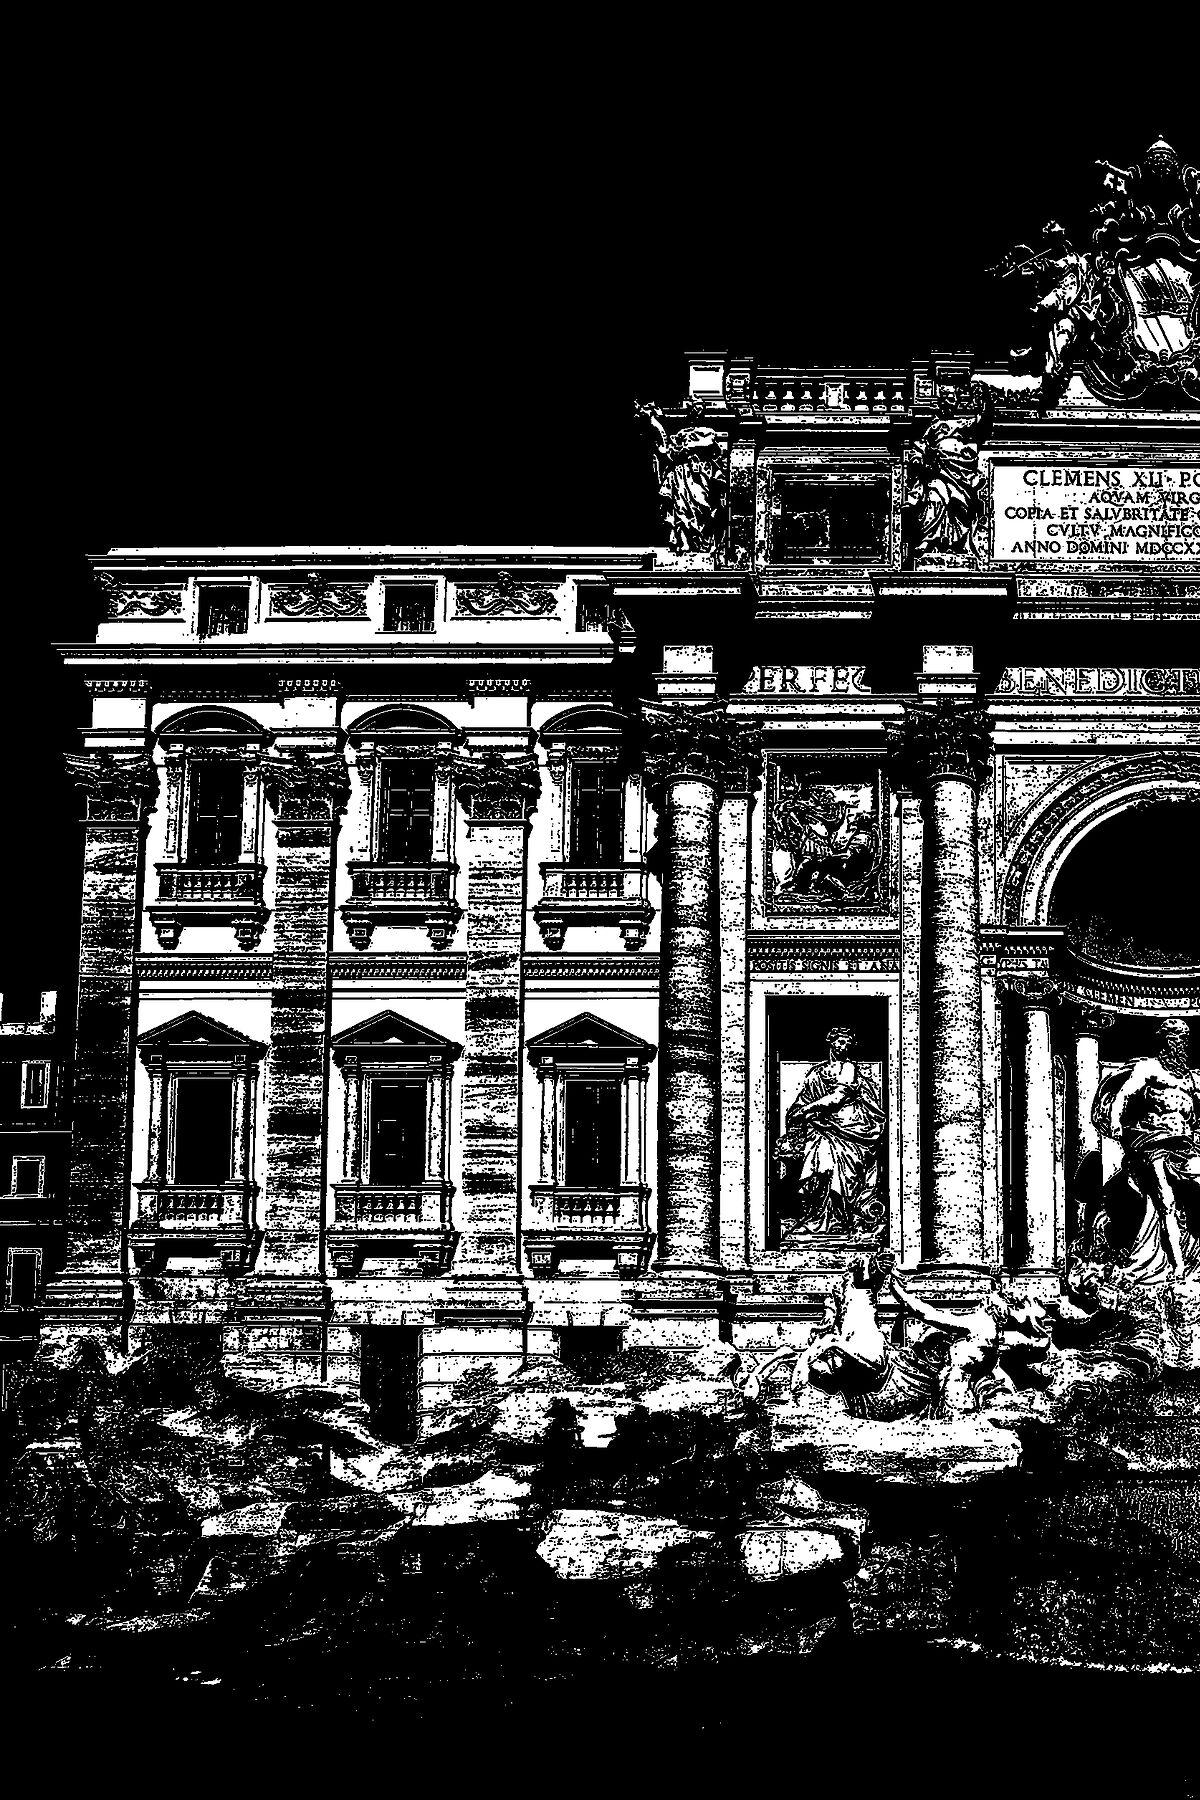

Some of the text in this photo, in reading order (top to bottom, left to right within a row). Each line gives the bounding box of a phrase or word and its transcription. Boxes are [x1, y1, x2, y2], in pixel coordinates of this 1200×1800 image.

[1023, 469, 1121, 487] CLEMENS
[1089, 491, 1150, 507] AQVAM
[1004, 506, 1053, 520] COPIA
[1060, 506, 1079, 520] ET
[1084, 507, 1189, 521] SALVBRITATE
[1047, 523, 1100, 537] CVLTV
[1011, 541, 1062, 554] ANNO
[1066, 541, 1128, 555] DOMINI
